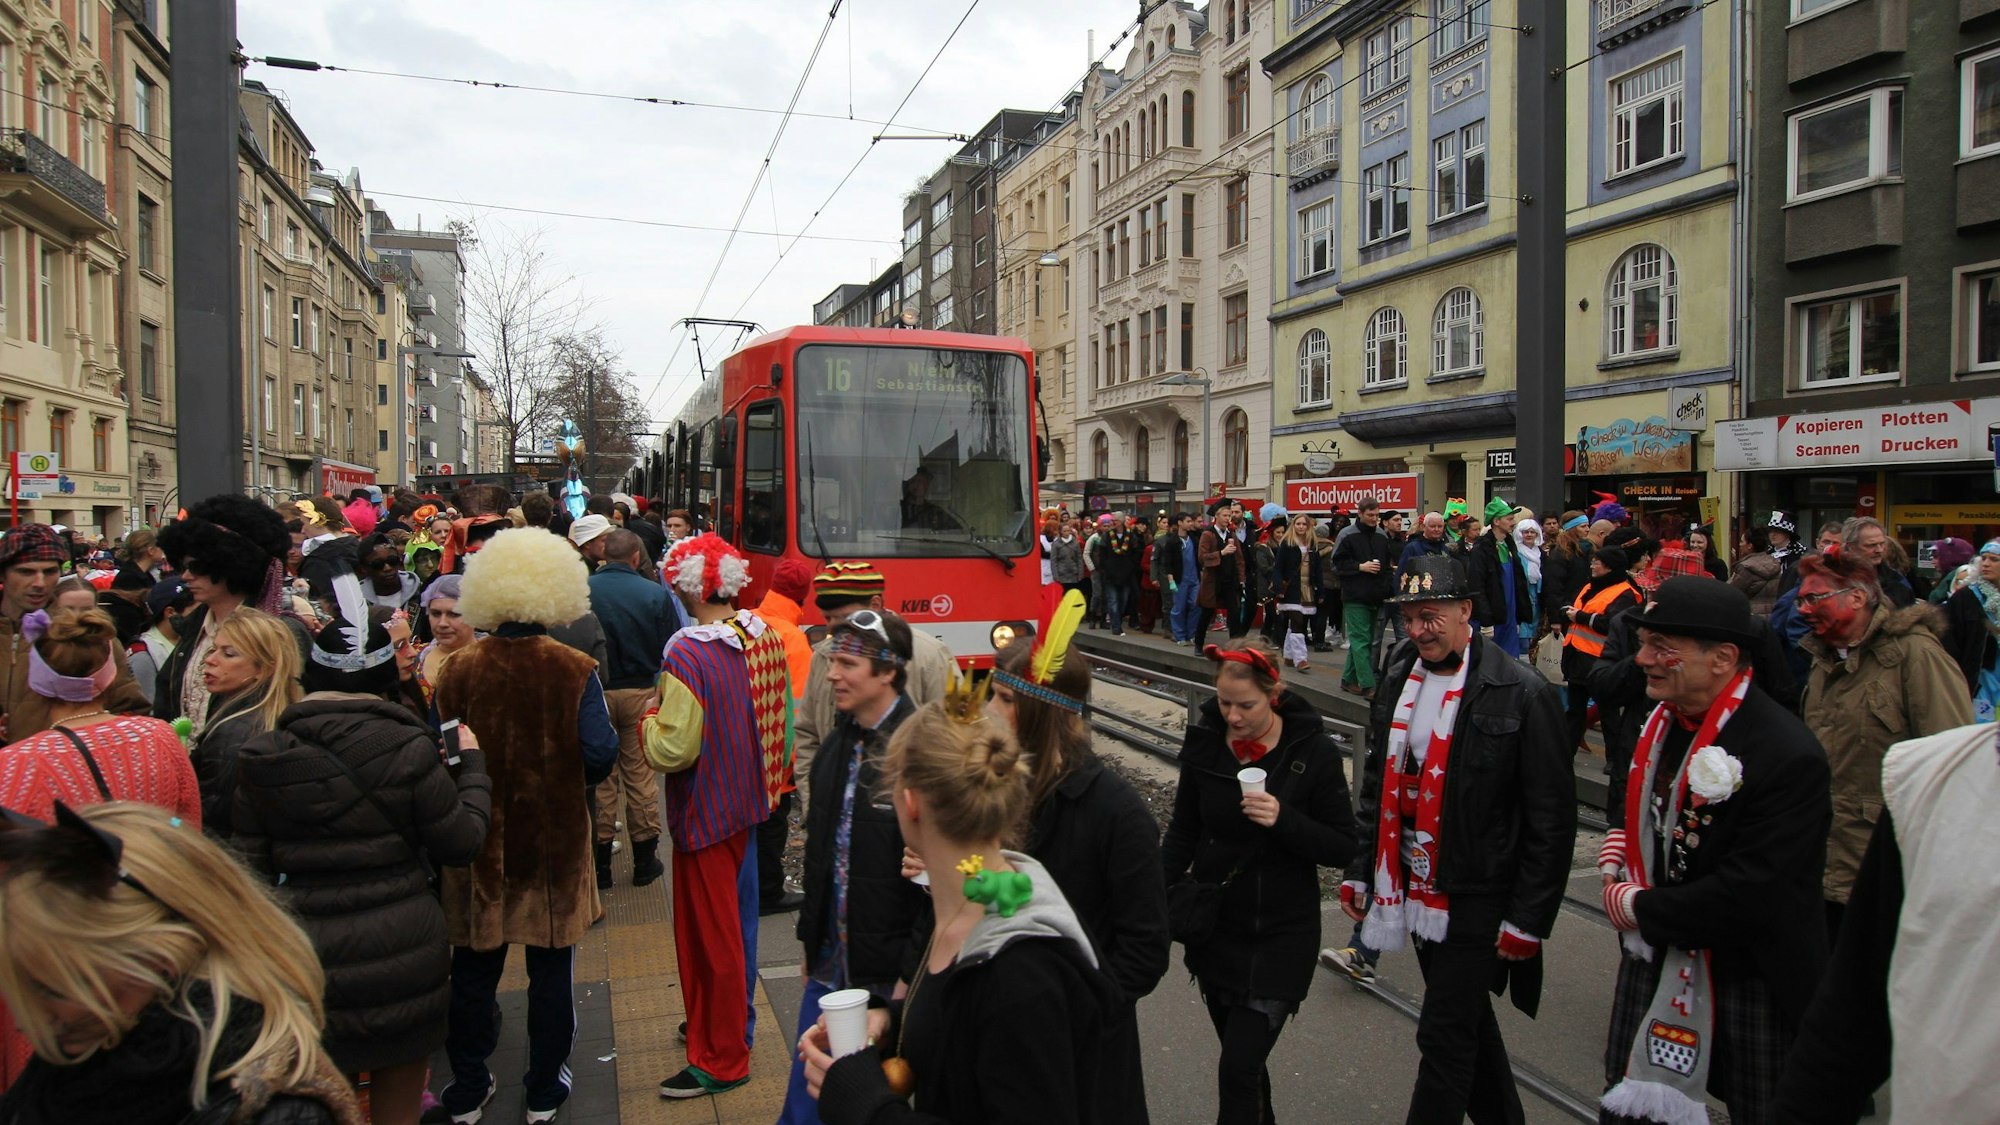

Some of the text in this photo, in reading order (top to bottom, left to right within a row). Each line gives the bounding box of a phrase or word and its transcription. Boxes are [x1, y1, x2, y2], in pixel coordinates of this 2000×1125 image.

[825, 357, 851, 391] 16
[1676, 392, 1703, 418] check
[1695, 407, 1704, 421] in
[1796, 411, 1949, 435] Kopieren Plotten
[1796, 437, 1958, 457] Scannen Drucken
[35, 458, 44, 469] H
[1299, 483, 1401, 508] Chlodwigplatz
[1623, 486, 1657, 495] CHECK
[1661, 486, 1672, 494] IN
[900, 599, 930, 613] KVB
